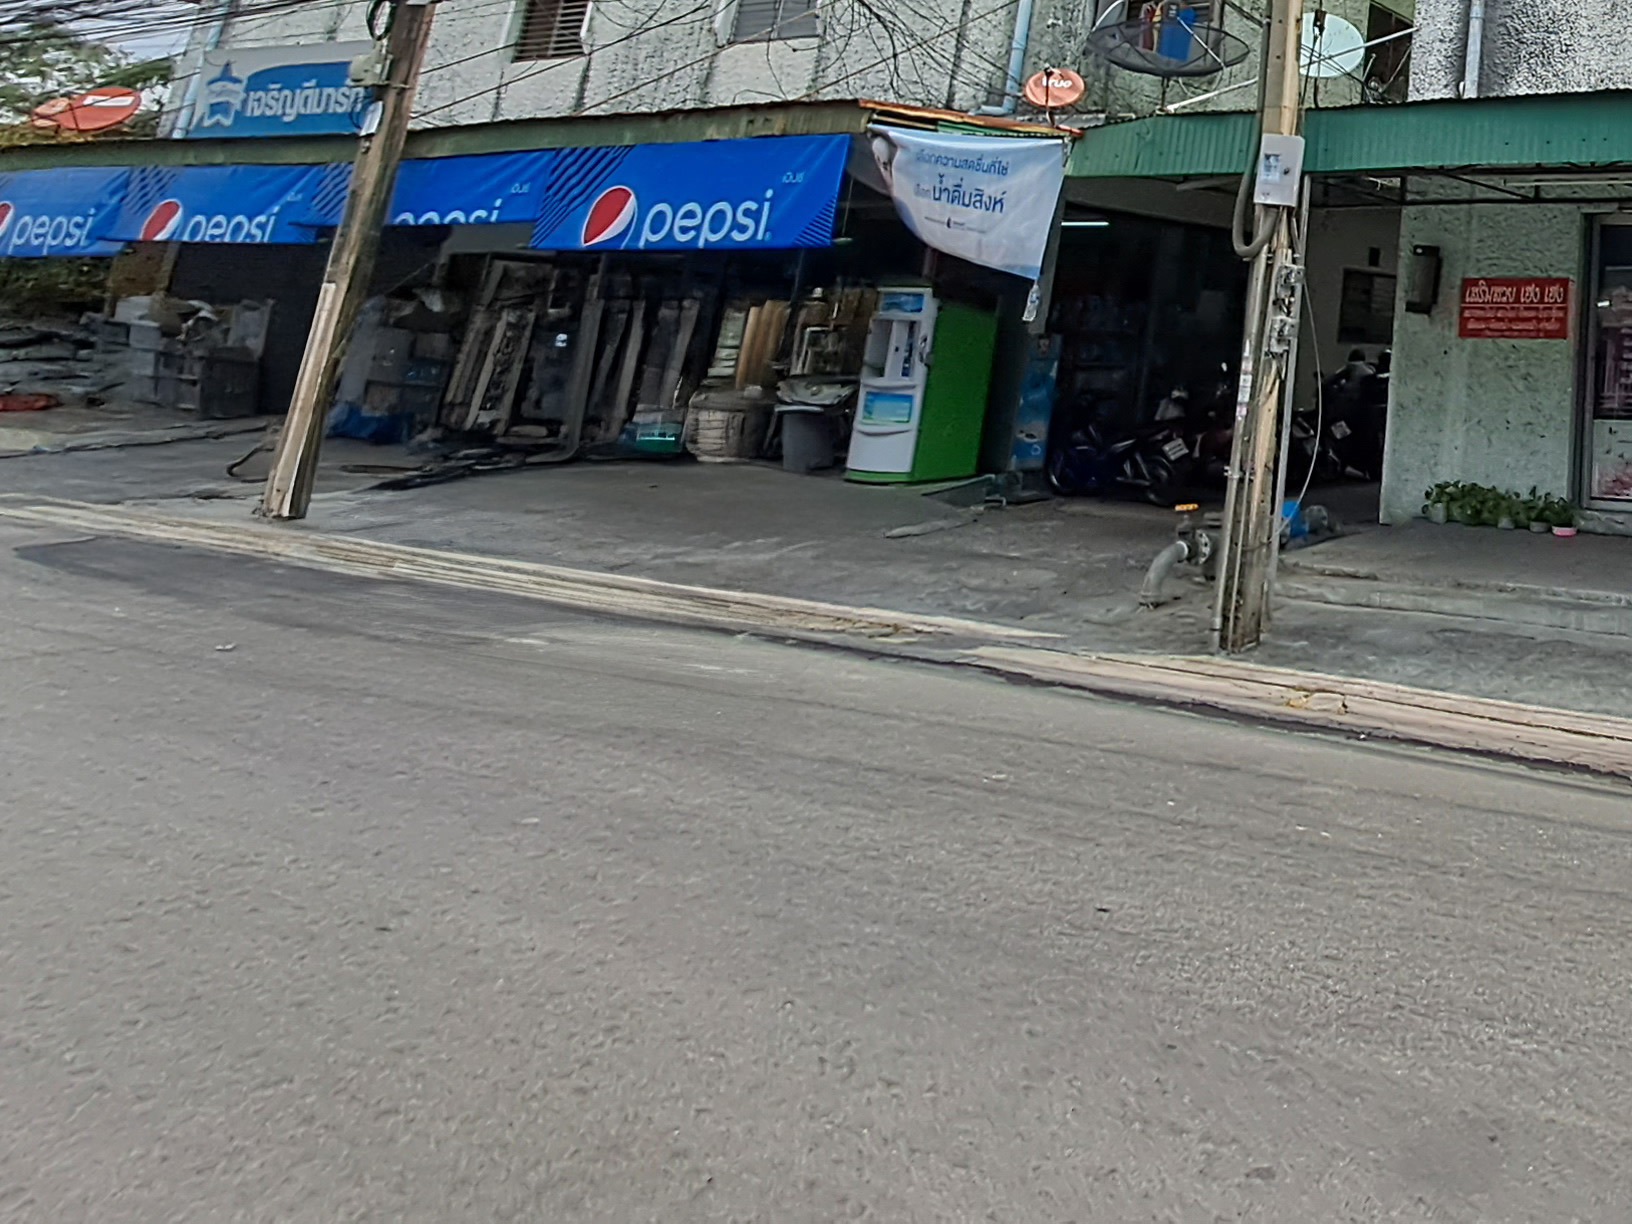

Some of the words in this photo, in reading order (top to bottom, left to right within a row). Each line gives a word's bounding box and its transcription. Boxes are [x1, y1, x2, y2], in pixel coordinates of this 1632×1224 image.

[8, 208, 97, 255] pepsi
[182, 205, 281, 243] pepsi
[637, 188, 774, 250] pepsi
